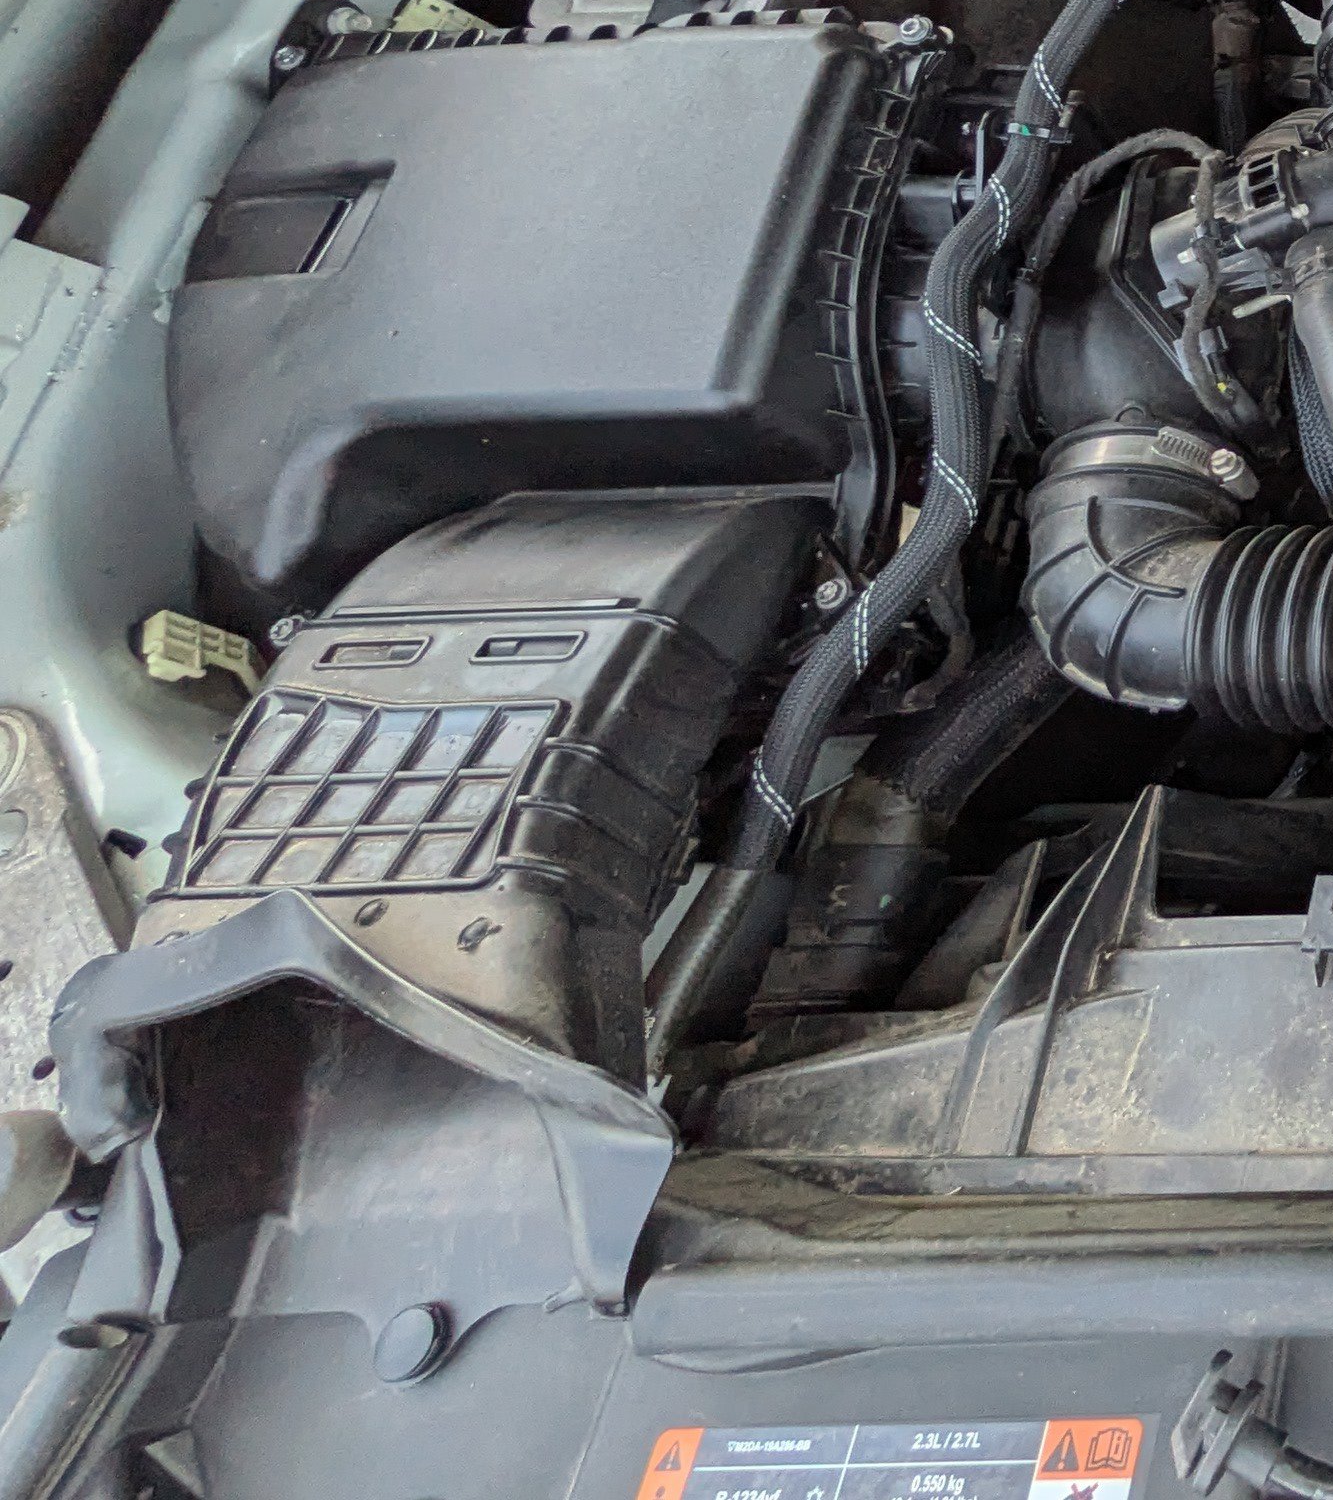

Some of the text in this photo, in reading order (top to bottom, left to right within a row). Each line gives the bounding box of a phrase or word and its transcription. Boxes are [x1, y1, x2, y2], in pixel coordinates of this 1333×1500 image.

[911, 1432, 942, 1450] 2.3L
[951, 1431, 982, 1449] 2.7L
[910, 1474, 966, 1496] 0.550 kg
